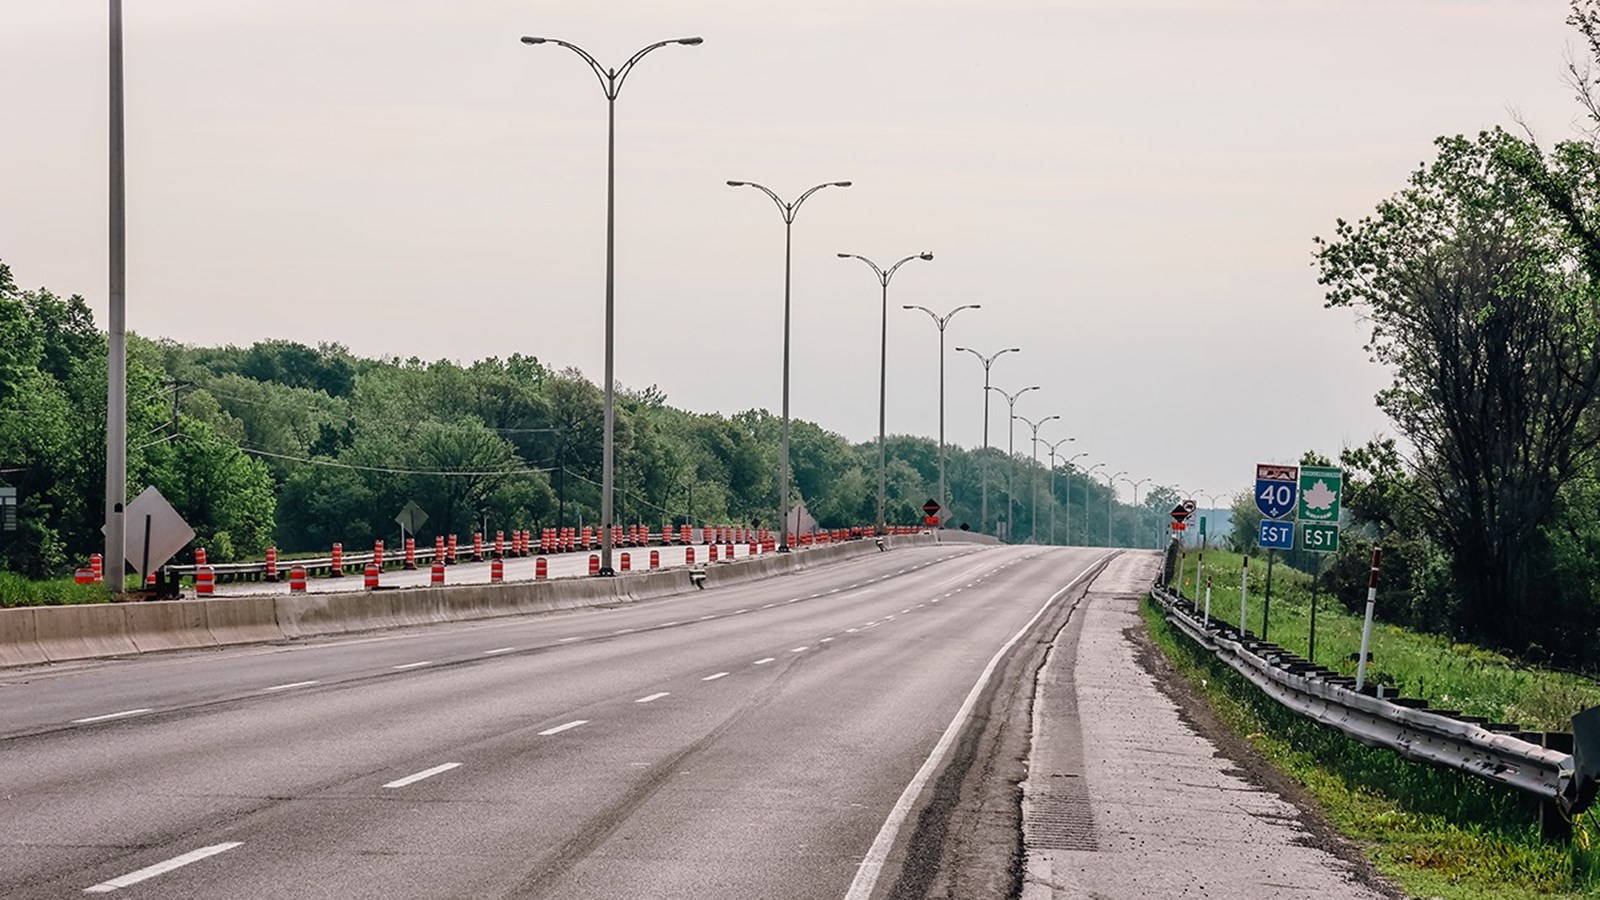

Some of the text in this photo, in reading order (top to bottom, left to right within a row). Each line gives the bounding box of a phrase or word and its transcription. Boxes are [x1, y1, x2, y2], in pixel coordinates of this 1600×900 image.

[1260, 485, 1291, 506] 40
[1262, 526, 1289, 542] EST
[1305, 529, 1334, 545] EST
